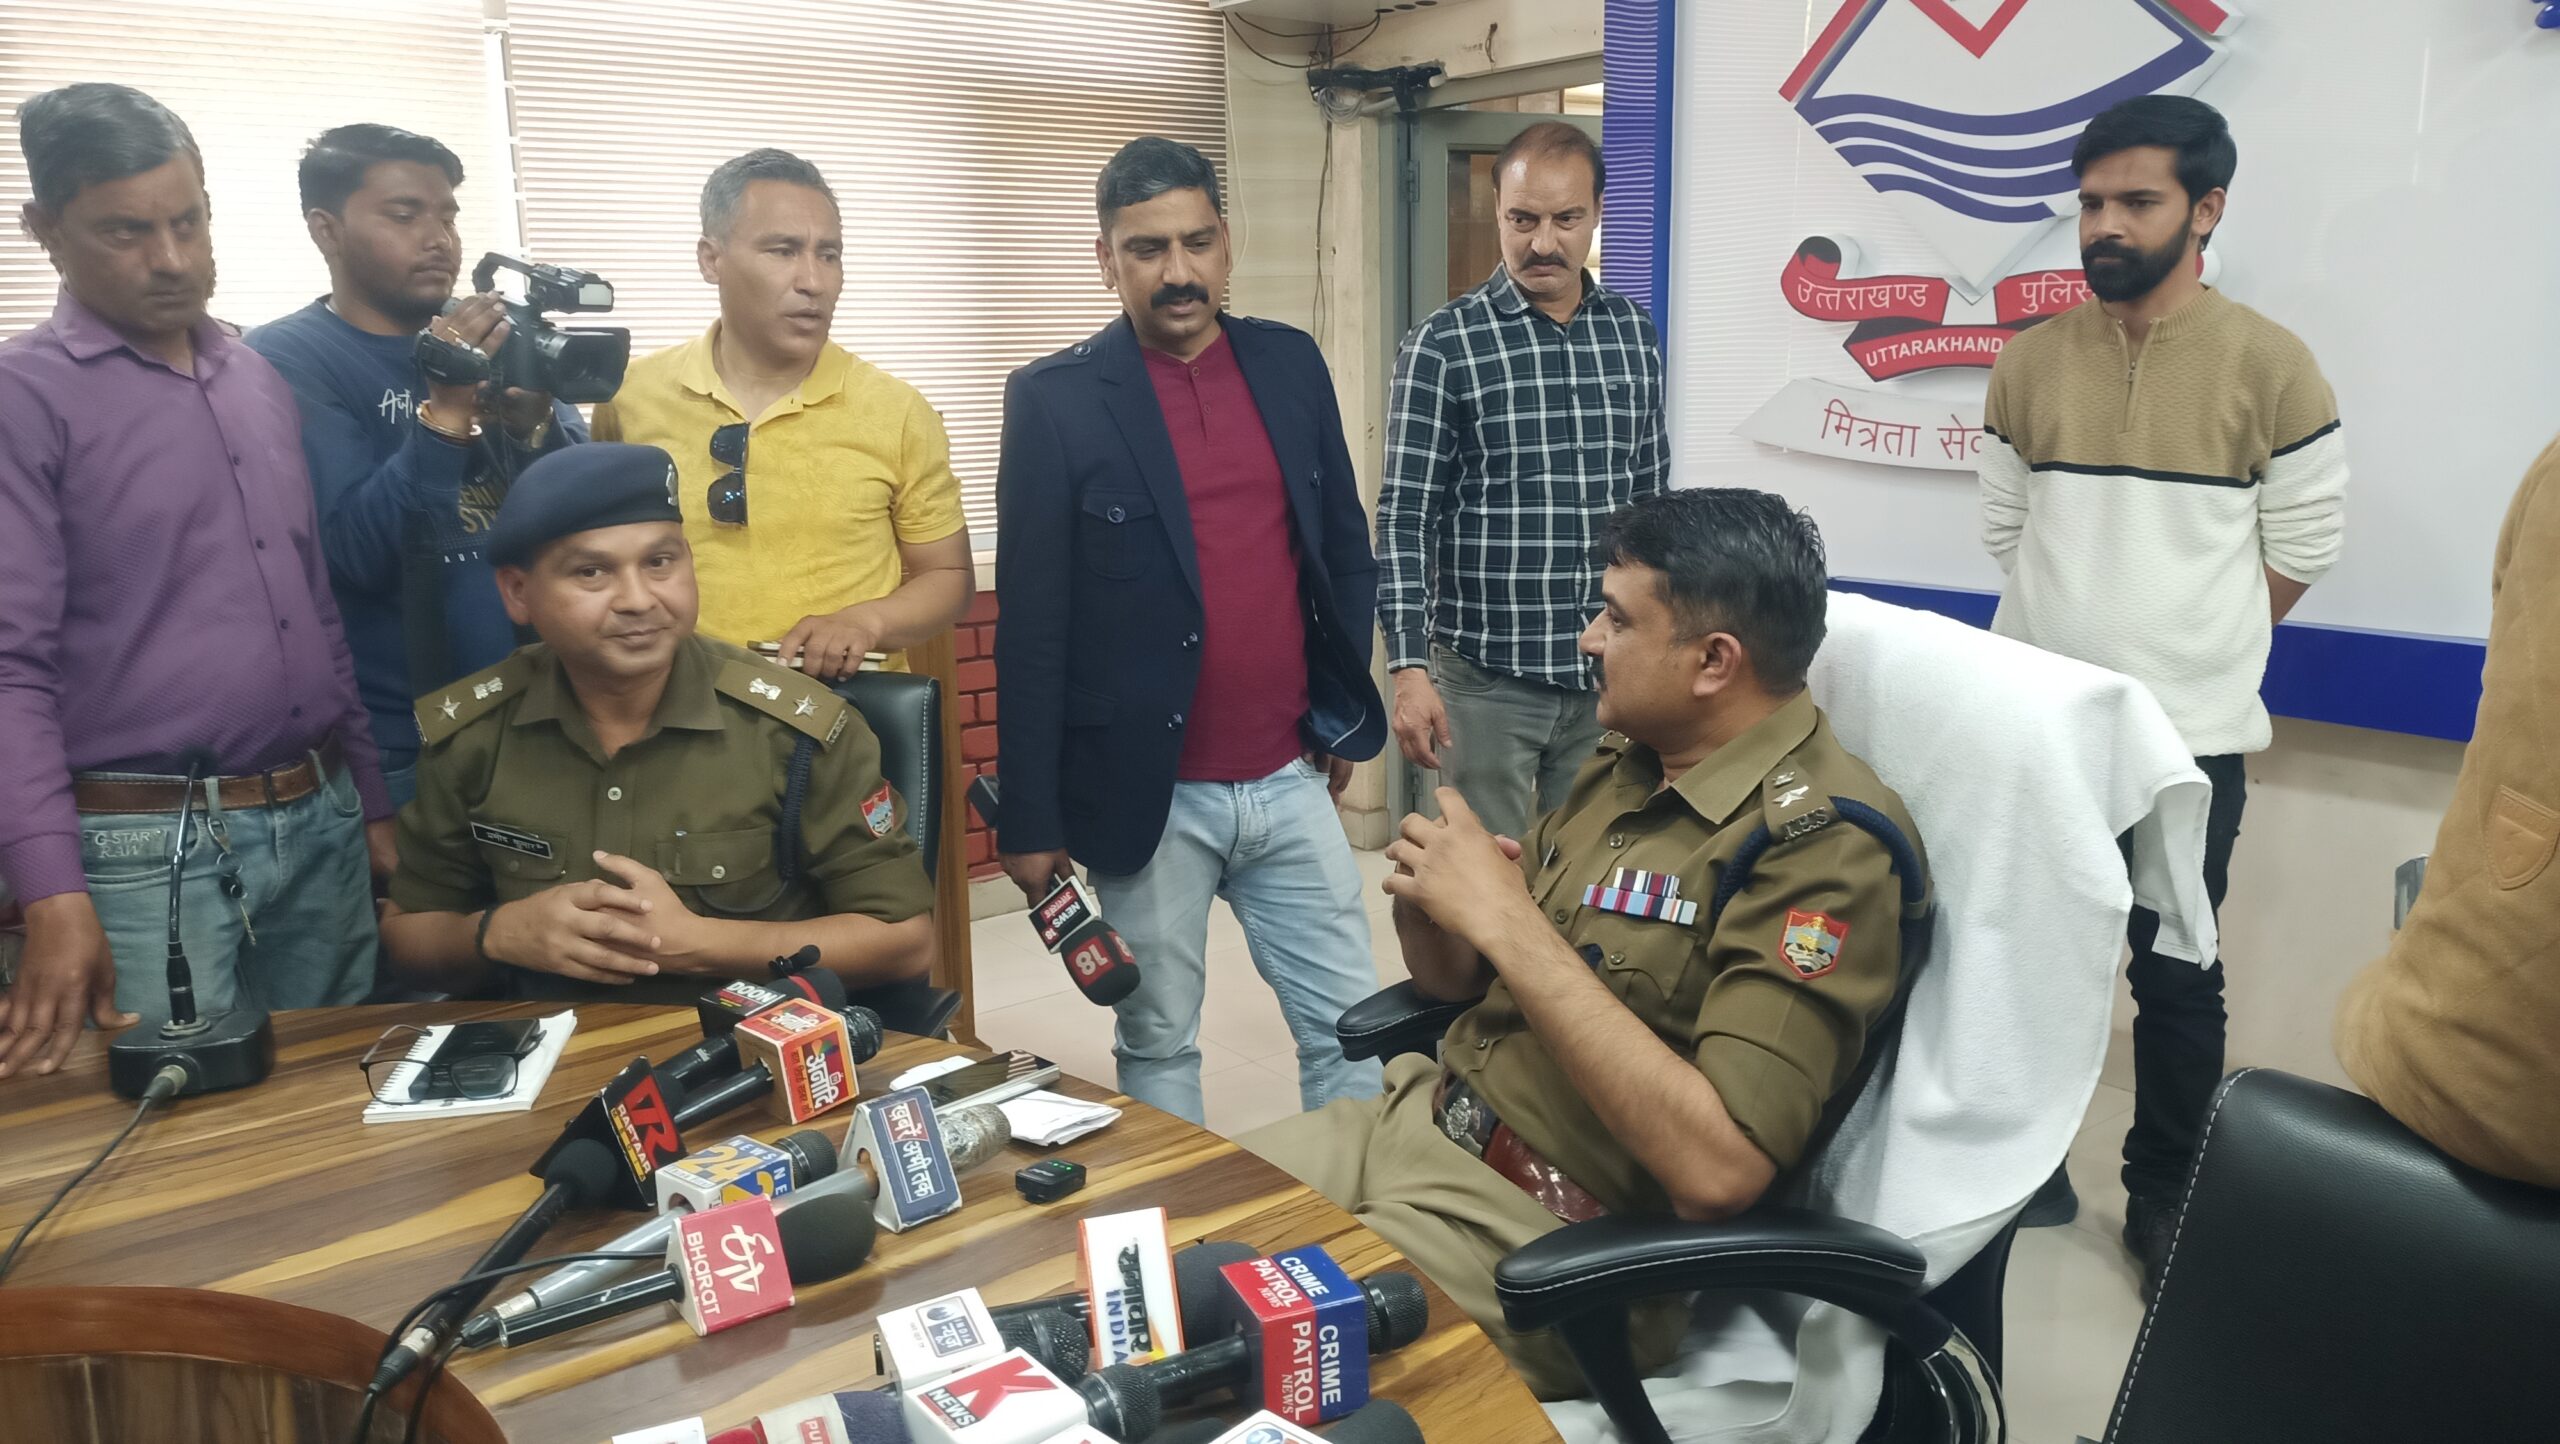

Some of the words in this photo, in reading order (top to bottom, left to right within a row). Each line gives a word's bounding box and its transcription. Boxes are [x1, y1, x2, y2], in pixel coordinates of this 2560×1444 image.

[1797, 276, 1929, 311] उत्तराखण्ड
[1866, 336, 2003, 367] UTTARAKHAND
[1821, 398, 1921, 458] मित्रता
[1052, 901, 1081, 928] NEWS
[1044, 928, 1058, 940] 18
[1075, 943, 1109, 976] 18
[726, 981, 779, 1003] DOON
[617, 1103, 652, 1175] RAFTAAR
[728, 1139, 778, 1161] NEWS
[677, 1146, 764, 1182] 24
[903, 1141, 932, 1173] अभी
[911, 1170, 935, 1198] तक
[1250, 1259, 1303, 1308] PATROL
[1280, 1256, 1330, 1298] CRIME
[1257, 1287, 1285, 1309] NEWS
[954, 1318, 974, 1346] INDIA
[1106, 1289, 1129, 1364] INDIA
[1292, 1321, 1314, 1421] PATROL
[1319, 1325, 1341, 1406] CRIME
[944, 1356, 1059, 1420] K
[1282, 1374, 1294, 1414] NEWS
[928, 1388, 976, 1427] NEWS
